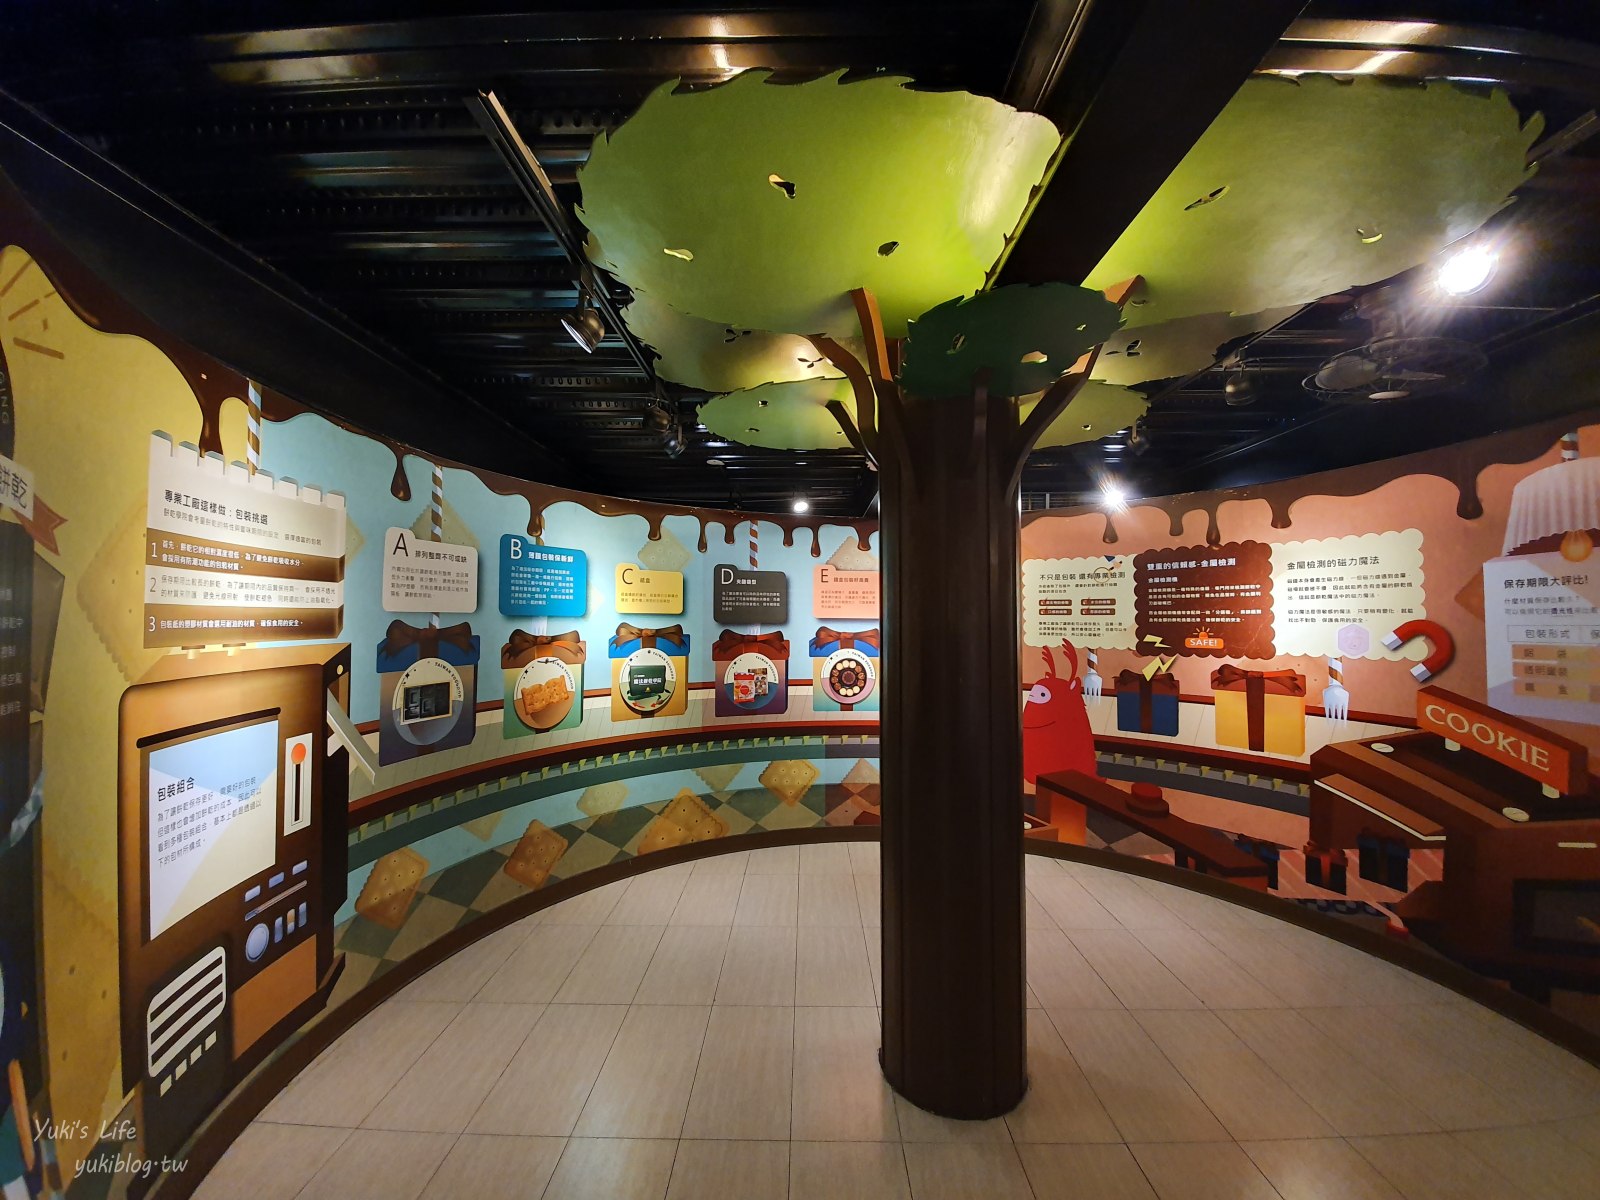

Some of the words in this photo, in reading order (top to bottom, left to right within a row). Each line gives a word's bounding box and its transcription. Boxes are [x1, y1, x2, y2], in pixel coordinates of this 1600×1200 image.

[151, 542, 158, 558] 1
[392, 532, 409, 557] A
[510, 538, 522, 559] B
[1287, 556, 1380, 570] 金屬檢測的磁力魔法
[622, 568, 633, 585] C
[721, 568, 734, 584] D
[821, 568, 829, 583] E
[149, 577, 157, 593] 2
[148, 616, 156, 632] 3
[1190, 638, 1217, 647] SAFE!
[1524, 629, 1570, 640] 包裝形式
[435, 662, 452, 674] TAIWAN
[1425, 704, 1550, 771] COOKIE
[157, 777, 194, 802] 包裝組合
